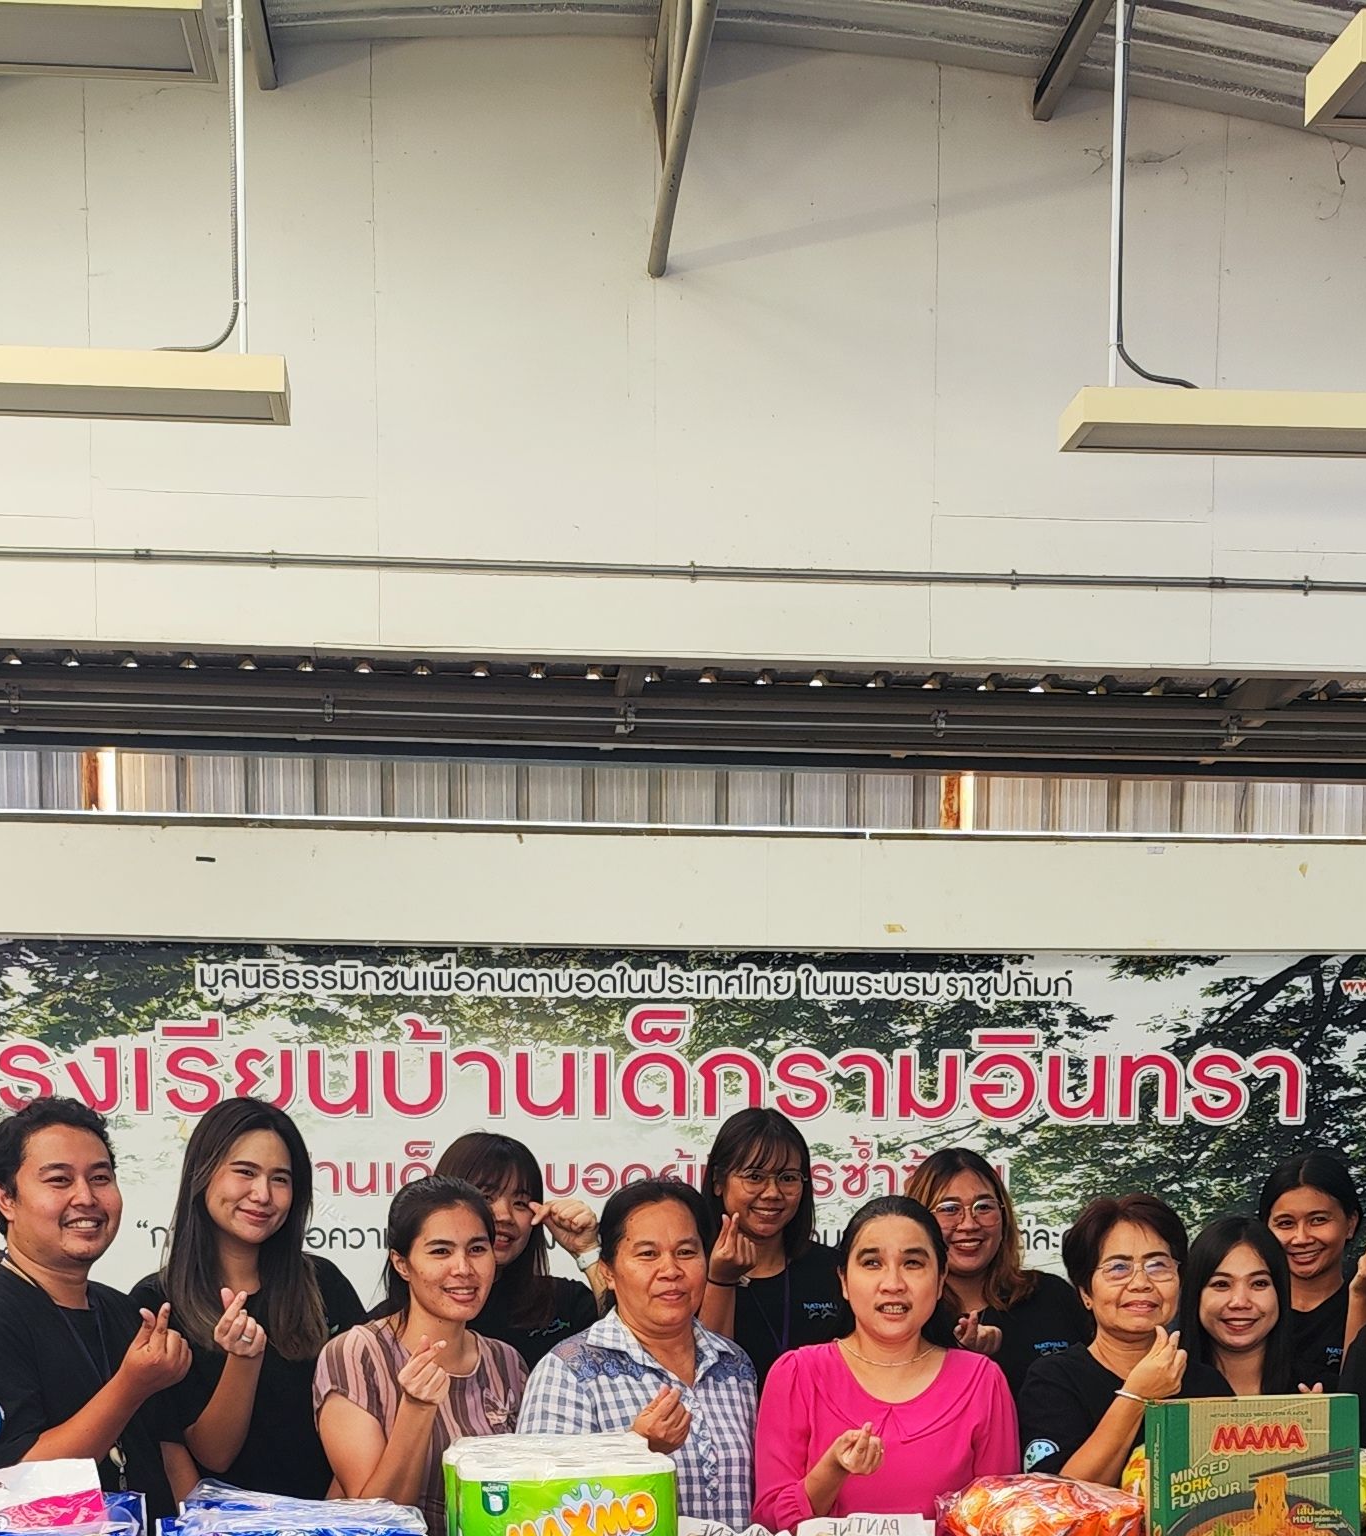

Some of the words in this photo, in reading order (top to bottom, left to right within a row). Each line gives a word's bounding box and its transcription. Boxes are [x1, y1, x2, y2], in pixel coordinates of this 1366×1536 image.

[1212, 1423, 1306, 1452] MAMA
[1170, 1459, 1230, 1485] MINCED
[1170, 1475, 1212, 1498] PORK
[1171, 1481, 1241, 1510] FLAVOUR
